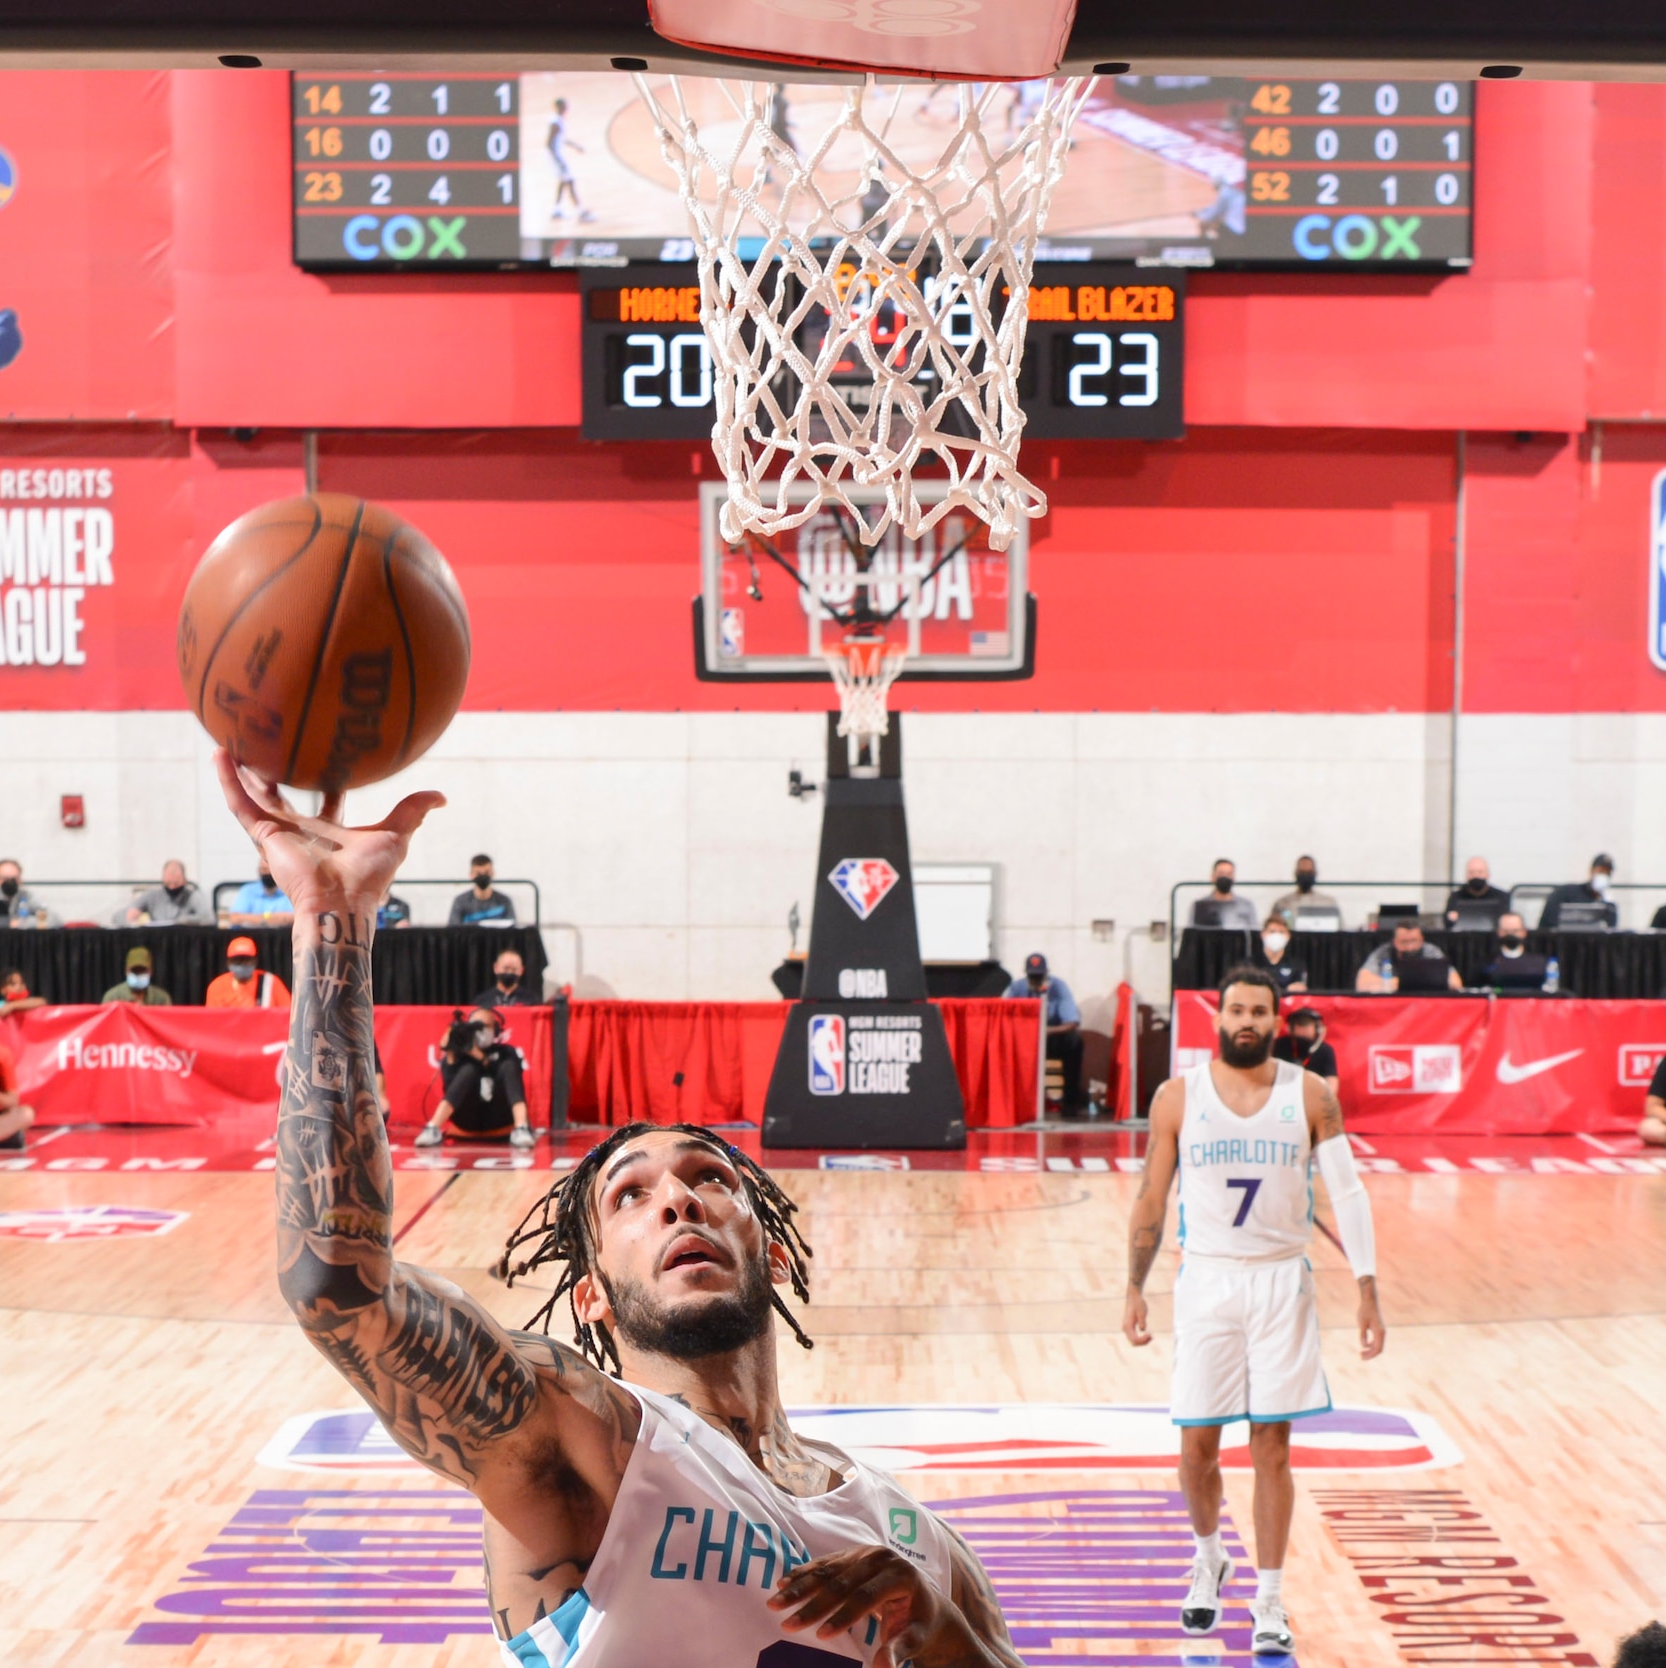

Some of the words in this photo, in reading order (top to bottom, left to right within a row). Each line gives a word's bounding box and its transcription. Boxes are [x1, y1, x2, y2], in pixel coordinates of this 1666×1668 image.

[304, 85, 342, 114] 14
[369, 83, 391, 114] 2
[432, 84, 448, 114] 1
[495, 83, 511, 113] 1
[1251, 85, 1291, 114] 42
[1318, 83, 1340, 114] 2
[1375, 84, 1398, 115] 0
[1435, 83, 1458, 114] 0
[304, 127, 343, 156] 16
[369, 129, 392, 160] 0
[427, 129, 449, 160] 0
[487, 130, 509, 161] 0
[1250, 127, 1291, 156] 46
[1316, 129, 1338, 160] 0
[1375, 129, 1398, 160] 0
[1443, 131, 1459, 161] 1
[304, 172, 343, 201] 23
[370, 173, 392, 205] 2
[428, 175, 451, 206] 4
[497, 173, 512, 204] 1
[1252, 172, 1290, 201] 52
[1317, 173, 1339, 204] 2
[1381, 175, 1397, 206] 1
[1435, 173, 1458, 204] 0
[343, 214, 467, 260] COX
[1293, 214, 1421, 260] COX
[620, 287, 700, 322] HORNE
[1077, 286, 1175, 321] BLAZER
[623, 334, 712, 407] 20
[1069, 333, 1159, 406] 23
[0, 469, 113, 499] RESORTS
[838, 969, 888, 998] @NBA
[57, 1037, 197, 1078] Hennessy
[849, 1031, 922, 1063] SUMMER
[848, 1063, 910, 1094] LEAGUE
[1190, 1139, 1299, 1167] CHARLOTTE
[1226, 1178, 1263, 1227] 7
[1308, 1489, 1501, 1543] MGM
